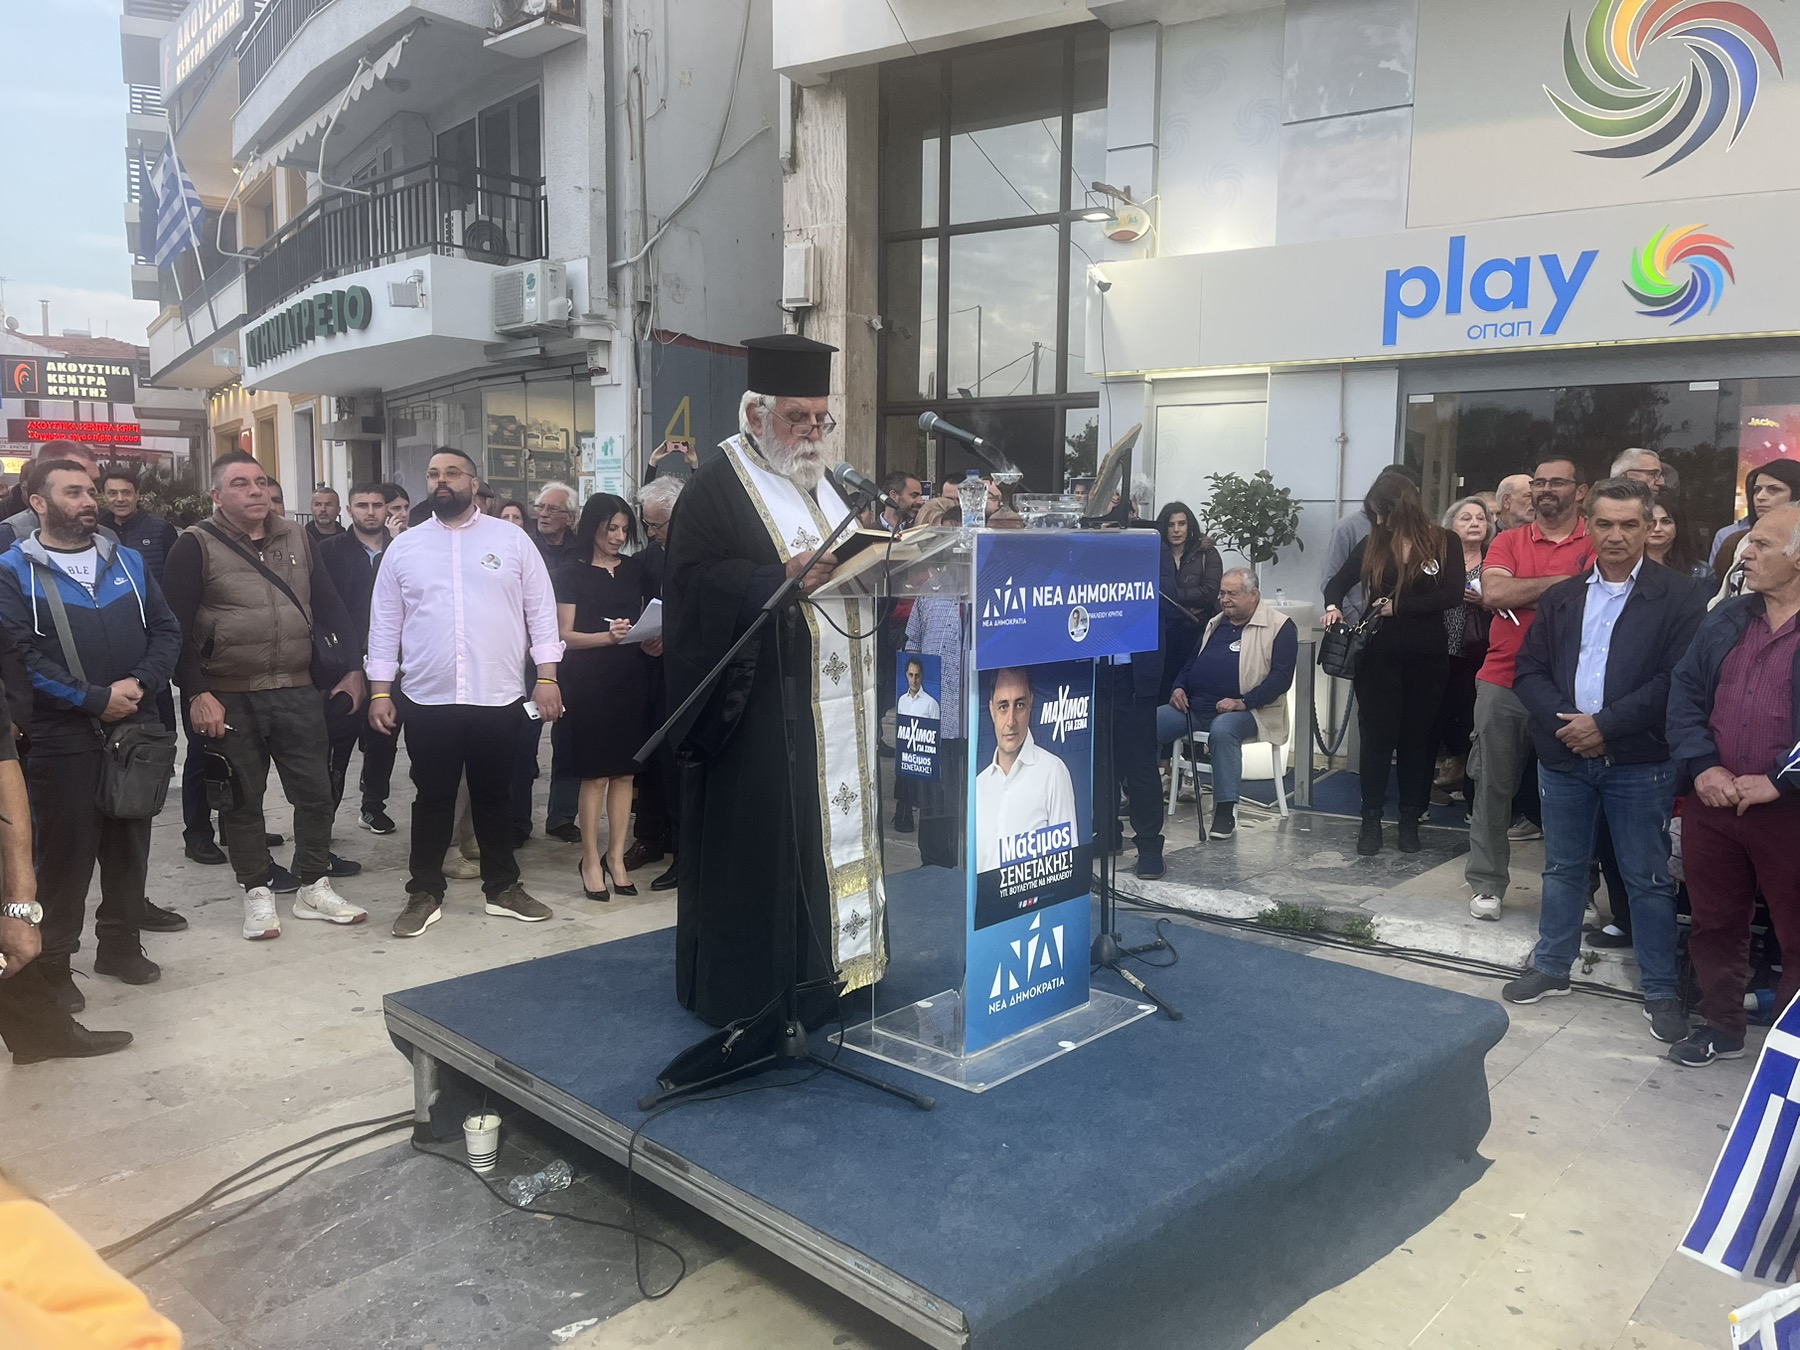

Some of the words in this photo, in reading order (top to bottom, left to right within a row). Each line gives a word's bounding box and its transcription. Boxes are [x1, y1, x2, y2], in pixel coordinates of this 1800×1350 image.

[1382, 235, 1600, 346] play
[246, 284, 373, 368] ΚΤΗΝΙΑΤΡΕΙΟ
[46, 361, 131, 376] ΑΚΟΥΣΤΙΚΑ
[46, 373, 107, 386] ΚΕΝΤΡΑ
[47, 385, 108, 398] ΚΡΗΤΗΣ
[1032, 585, 1063, 607] ΝΕΑ
[1067, 581, 1155, 605] ΔΗΜΟΚΡΑΤΙΑ
[994, 617, 1027, 627] ΔΗΜΟΚΡΑΤΙΑ
[1065, 720, 1073, 732] ΓΙΑ
[1001, 826, 1070, 863] Μάξιμος
[1000, 849, 1073, 889] ΣΕΝΕΤΑΚΗΣ!
[1009, 879, 1038, 896] ΒΟΥΛΕΥΤΗΣ
[1046, 869, 1073, 885] ΗΡΑΚΛΕΙΟΥ
[988, 998, 1007, 1015] ΝΕΑ
[1009, 976, 1066, 1007] ΔΗΜΟΚΡΑΤΙΑ
